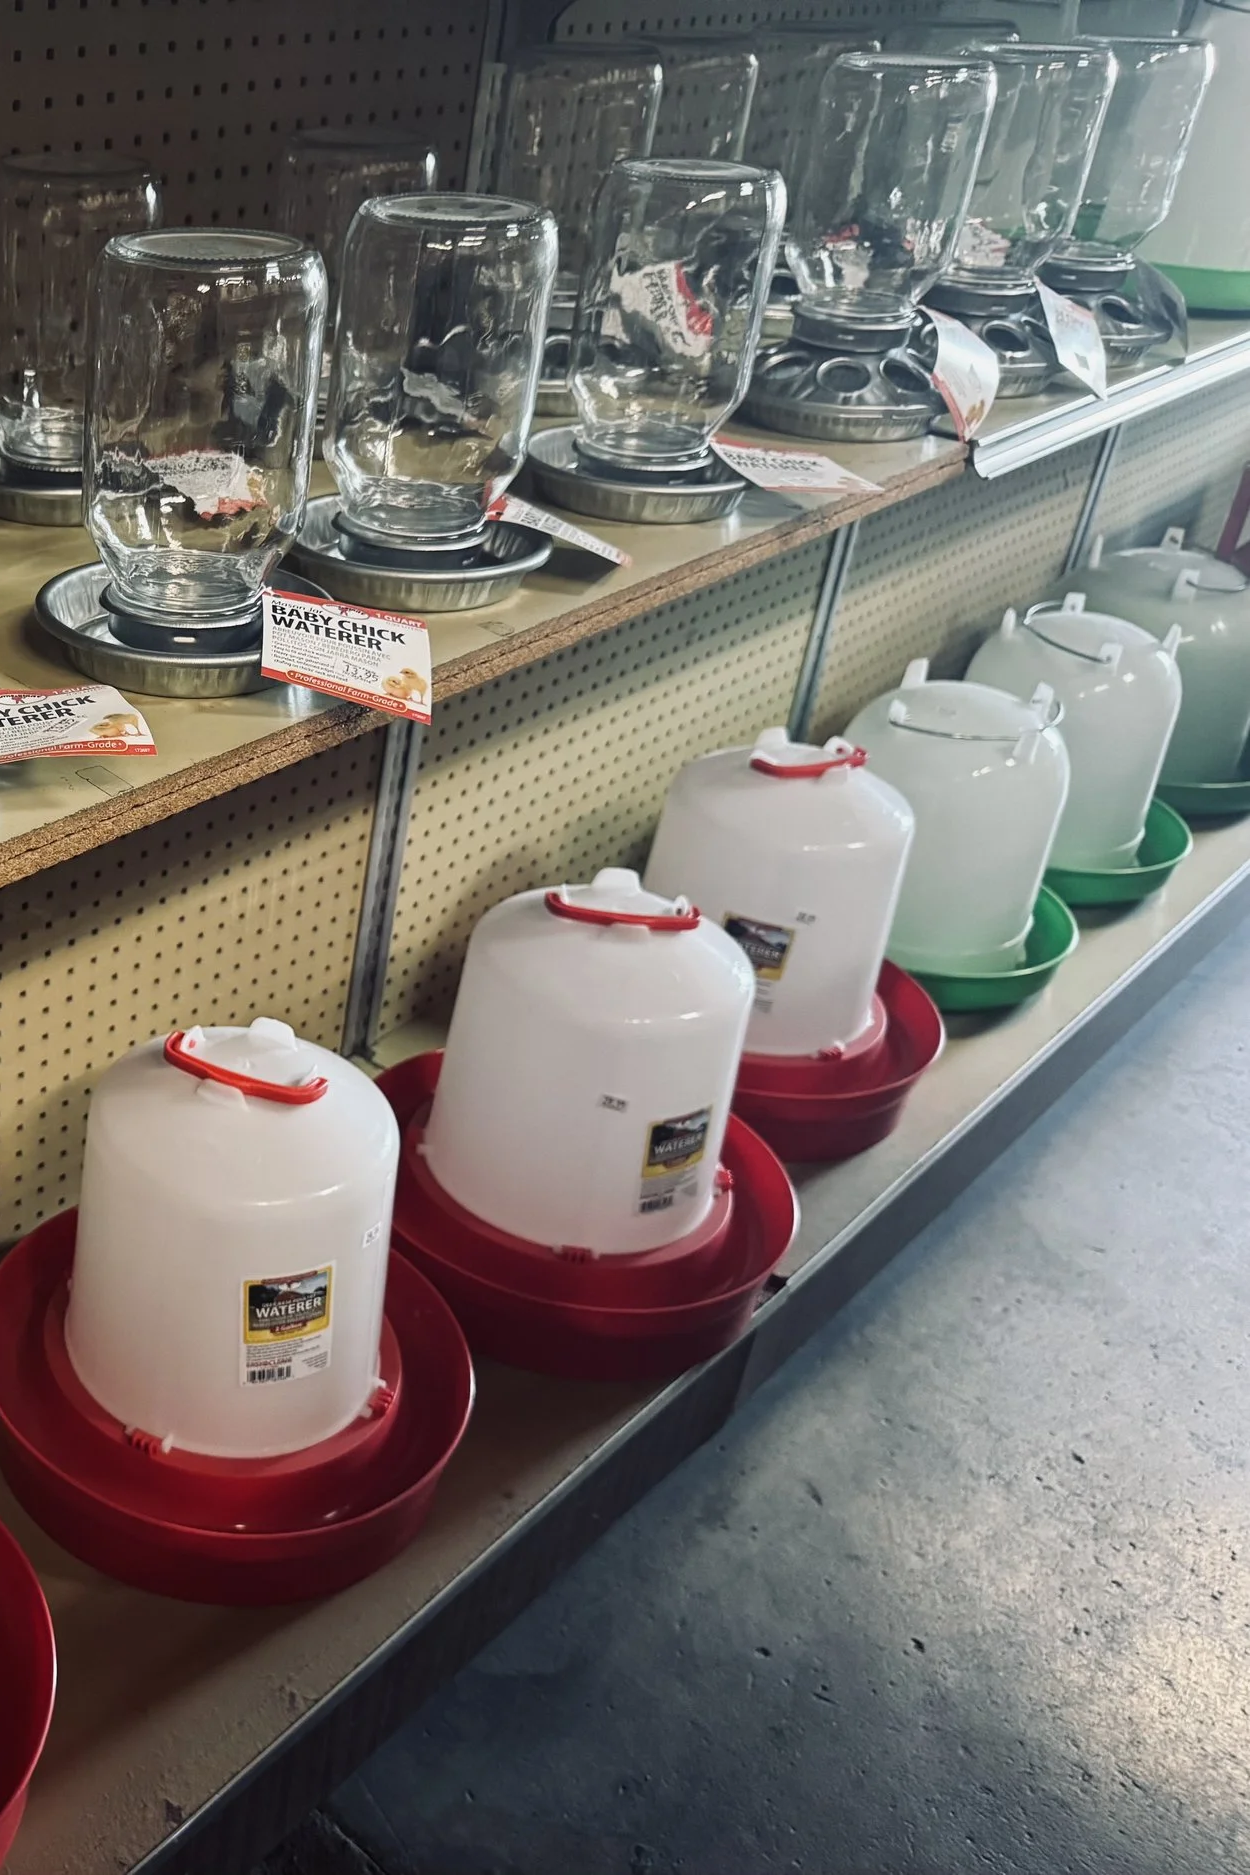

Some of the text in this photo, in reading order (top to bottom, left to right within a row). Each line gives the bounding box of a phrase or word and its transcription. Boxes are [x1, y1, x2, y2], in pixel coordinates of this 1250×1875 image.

[271, 600, 306, 611] Mason
[271, 604, 333, 626] BABY
[338, 619, 406, 645] CHICK
[383, 614, 423, 628] QUART
[271, 614, 382, 651] WATERER
[371, 651, 391, 661] AVEC
[344, 664, 379, 682] 13.95
[295, 673, 346, 693] Professional
[347, 687, 399, 710] Farm-Grade
[17, 695, 96, 715] CHICK
[57, 740, 117, 751] Farm-Grade
[654, 1132, 703, 1155] WATERER
[255, 1297, 321, 1318] WATERER
